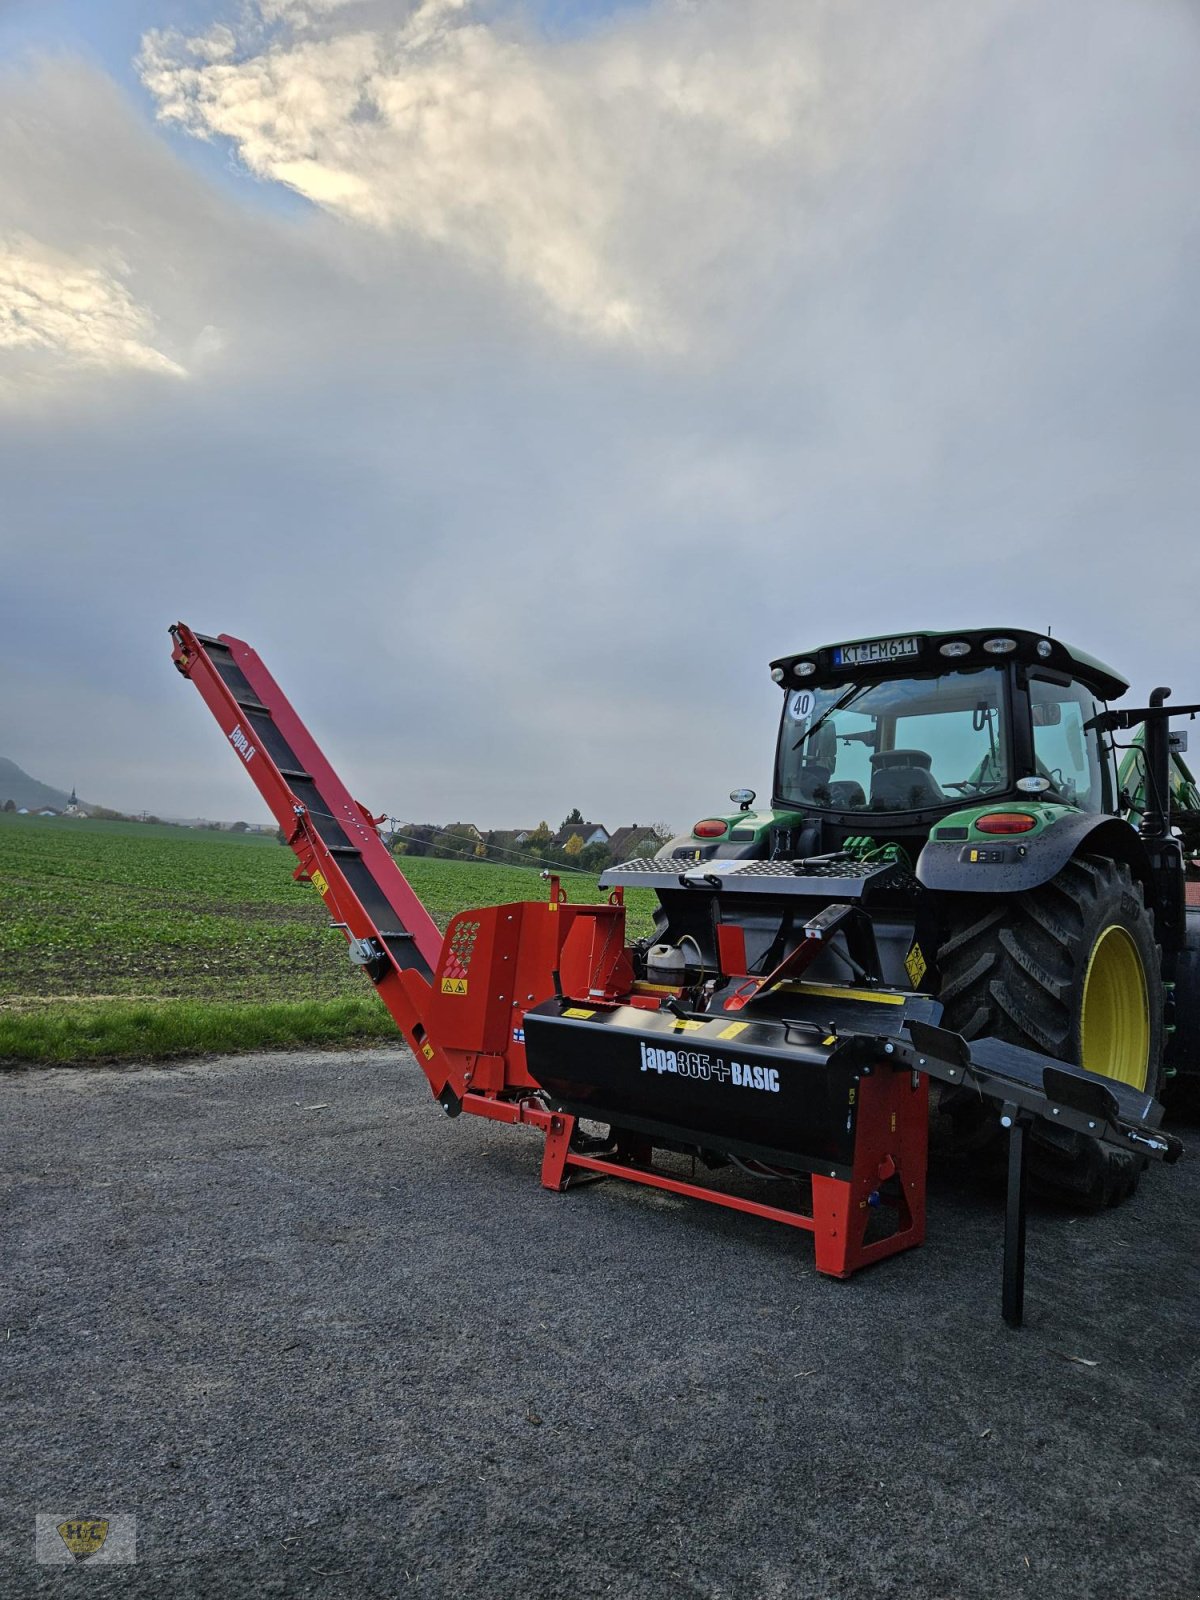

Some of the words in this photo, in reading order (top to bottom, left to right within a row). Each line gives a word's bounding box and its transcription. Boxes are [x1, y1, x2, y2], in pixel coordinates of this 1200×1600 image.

[842, 646, 860, 663] KT
[869, 639, 917, 660] FM611
[793, 694, 810, 715] 40
[228, 723, 256, 763] japa.fi
